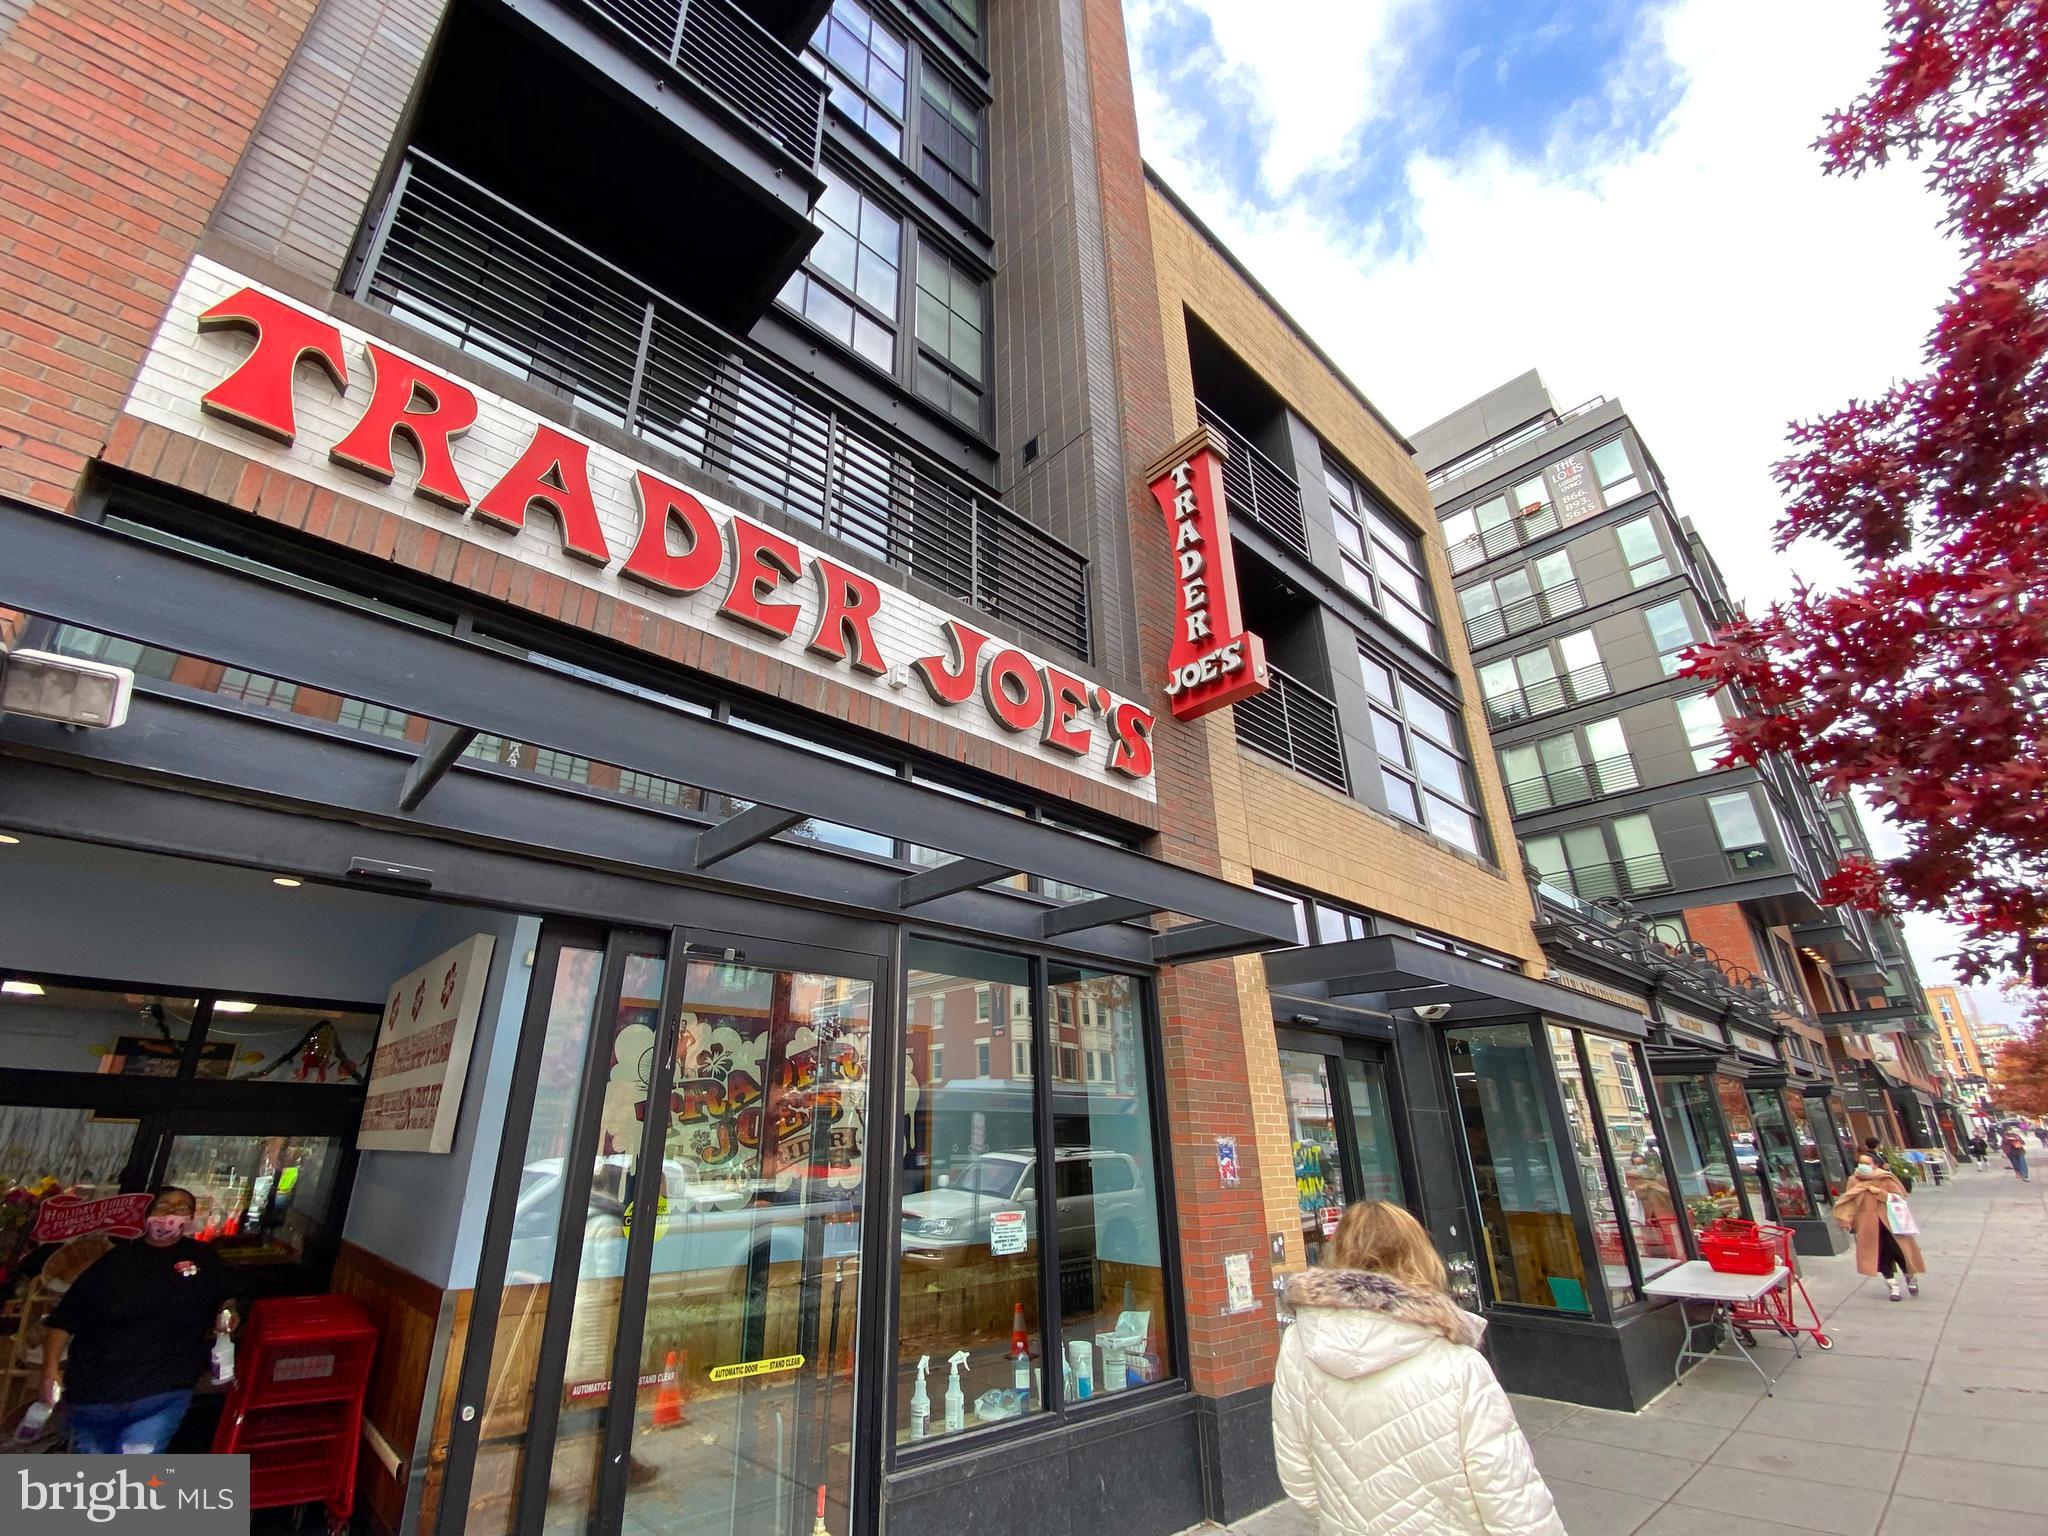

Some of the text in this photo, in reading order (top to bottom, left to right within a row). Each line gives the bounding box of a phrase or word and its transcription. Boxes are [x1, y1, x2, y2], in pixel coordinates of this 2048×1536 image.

[1552, 463, 1584, 483] LOUIS
[1554, 456, 1576, 472] THE
[1566, 503, 1595, 520] 5615
[198, 286, 1157, 779] TRADER JOE'S
[1170, 460, 1214, 645] TRADER
[1164, 640, 1244, 695] JOE'S
[715, 1357, 801, 1378] AUTOMATIC DOOR STAND CLEAR
[639, 1371, 675, 1386] STAND CLEAR
[572, 1382, 607, 1396] AUTOMATIC
